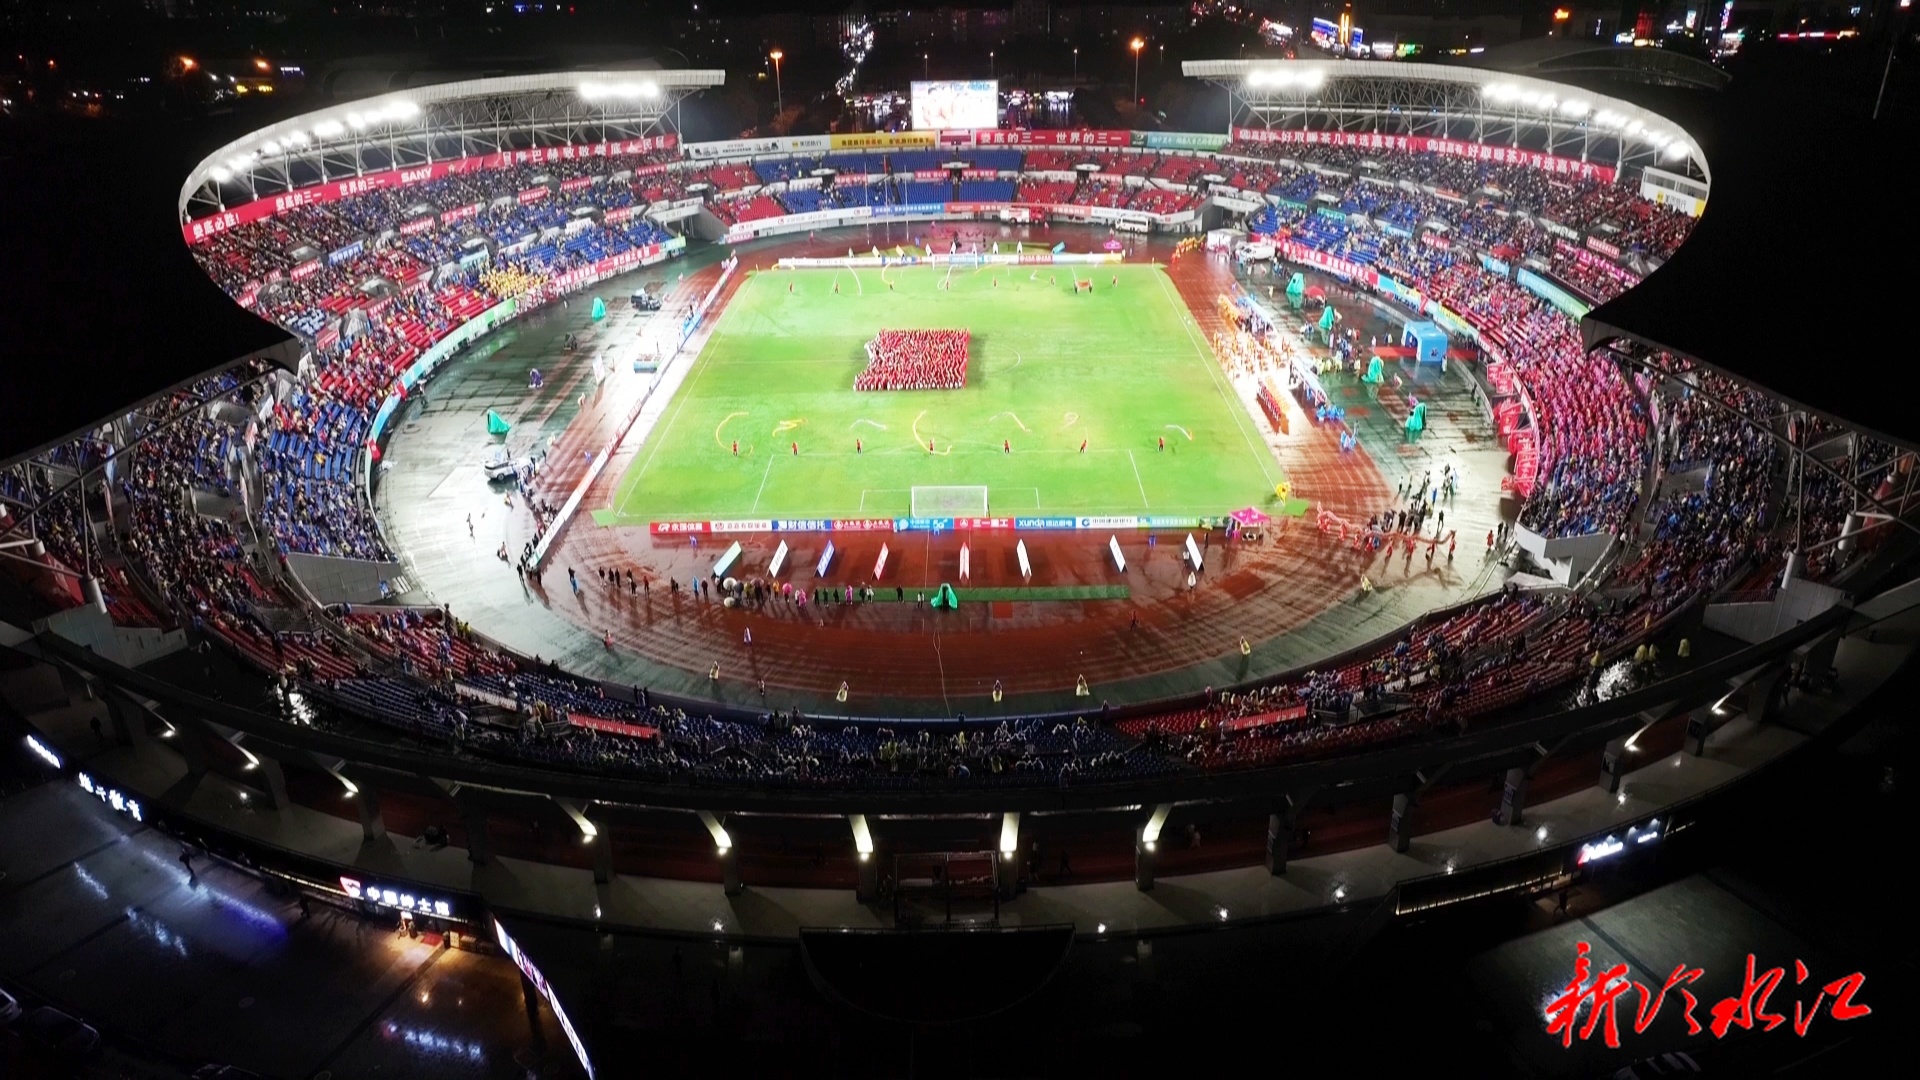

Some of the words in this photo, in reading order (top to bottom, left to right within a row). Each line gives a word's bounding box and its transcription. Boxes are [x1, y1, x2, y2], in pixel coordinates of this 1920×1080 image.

[980, 132, 1047, 146] 娄底的三一
[1055, 132, 1122, 146] 世界的三一
[275, 190, 323, 212] 娄底的三一
[338, 177, 384, 197] 世界的三一
[401, 167, 432, 184] SANY
[787, 520, 825, 530] 财信信托
[973, 519, 1009, 528] 三一重工
